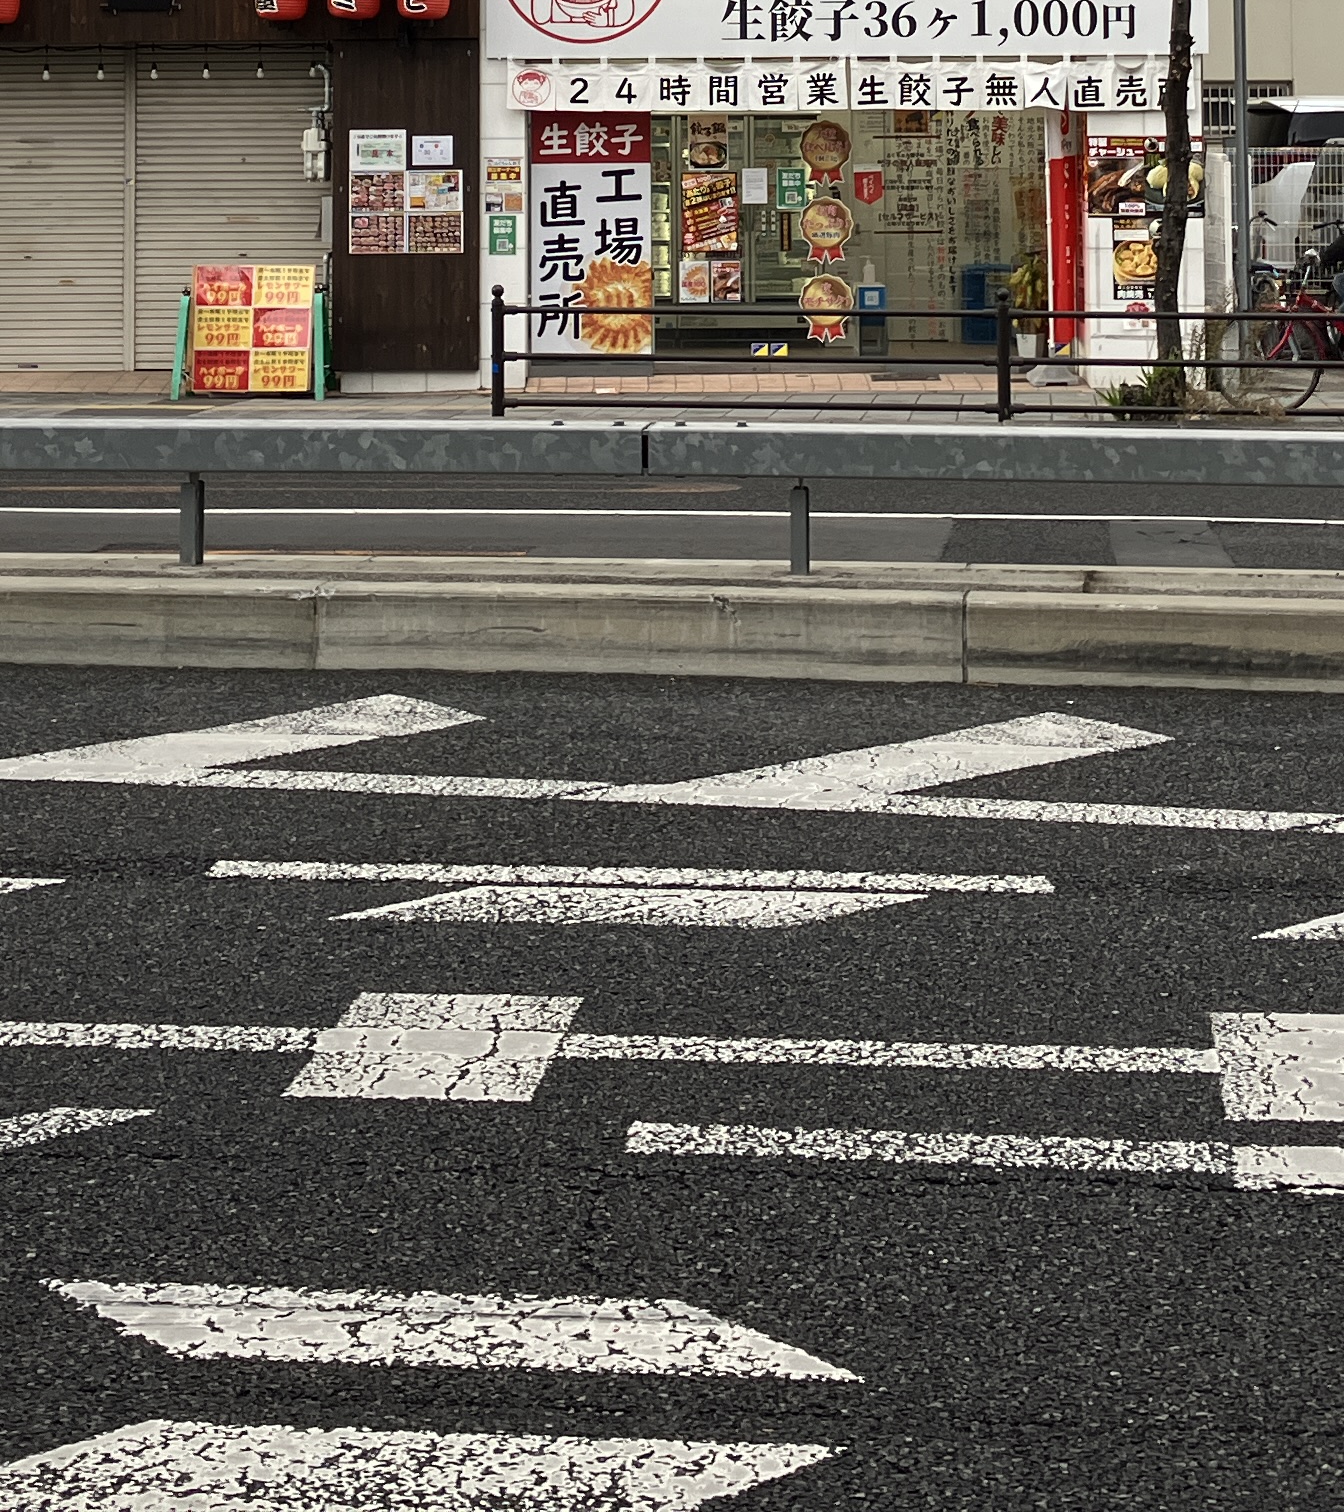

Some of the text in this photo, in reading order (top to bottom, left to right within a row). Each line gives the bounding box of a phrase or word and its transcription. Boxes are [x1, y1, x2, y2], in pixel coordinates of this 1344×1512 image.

[539, 122, 644, 157] 生餃子
[1089, 147, 1145, 157] チャーシュー
[594, 168, 644, 266] 工場
[537, 180, 586, 340] 直売所
